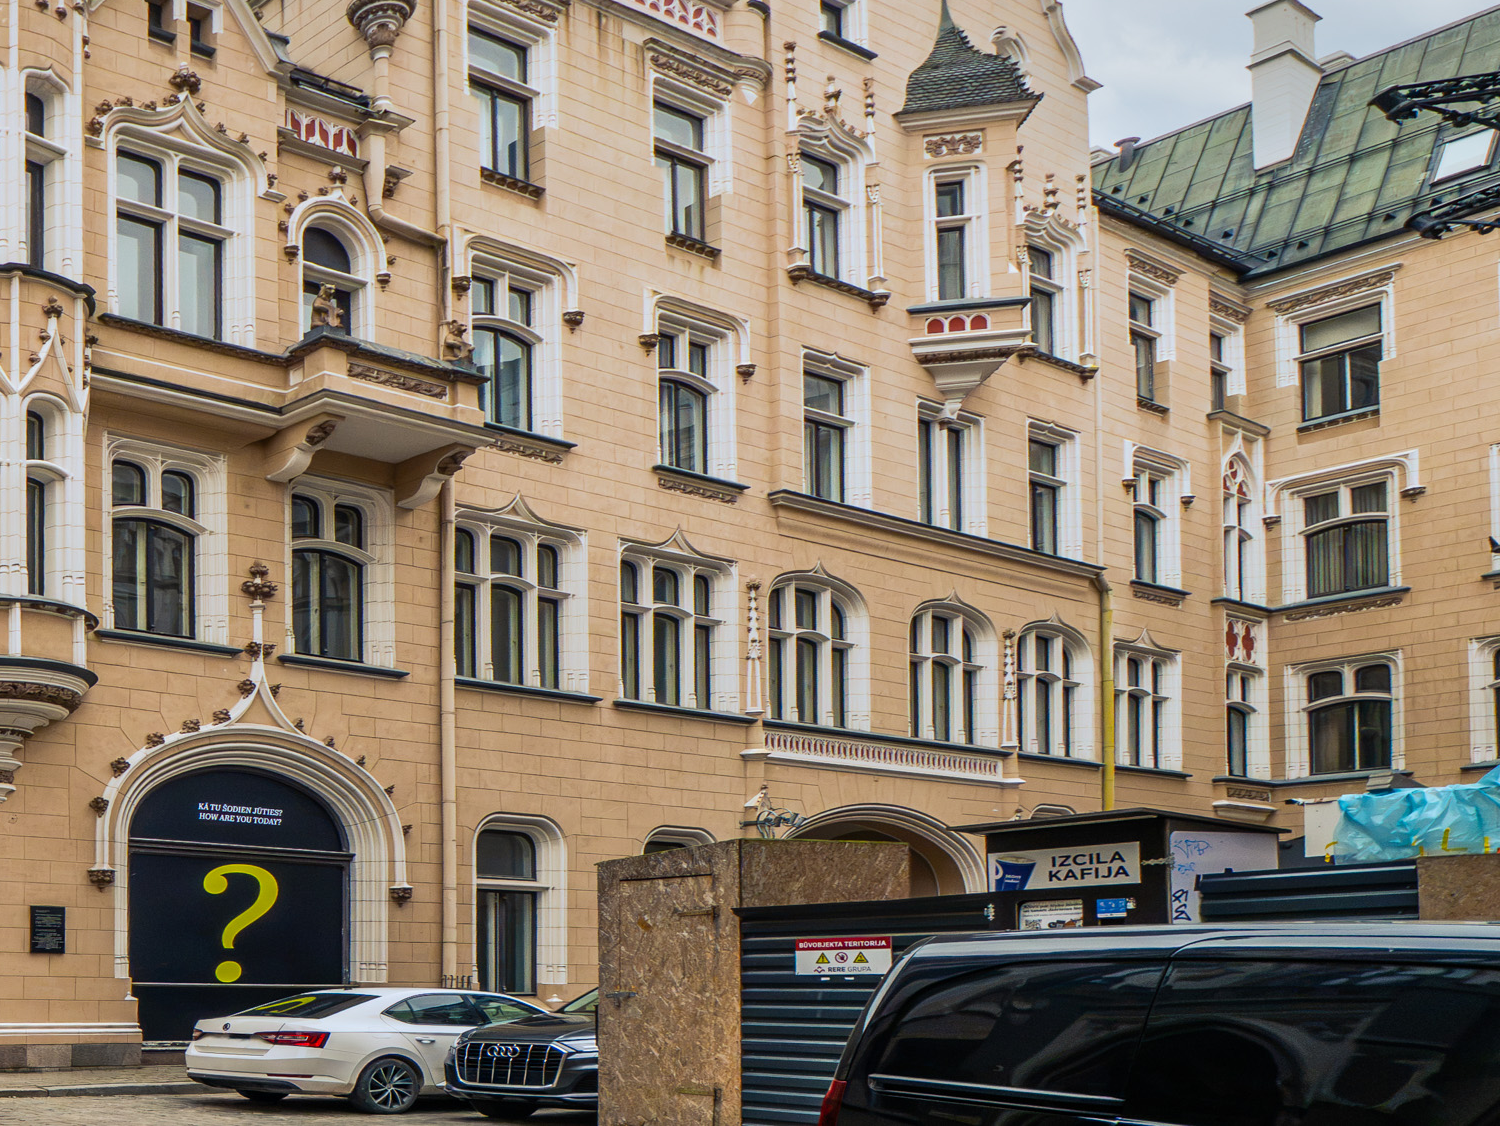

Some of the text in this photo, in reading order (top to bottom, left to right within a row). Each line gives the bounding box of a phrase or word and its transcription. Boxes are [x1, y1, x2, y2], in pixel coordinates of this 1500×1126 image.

[210, 803, 221, 811] TU
[222, 804, 252, 814] ŠODIEN
[198, 812, 282, 826] HOW ARE YOU TODAY?
[1051, 851, 1126, 867] IZCILA
[1048, 865, 1130, 882] KAFIJA
[799, 941, 843, 949] BŪVOBJEKTA
